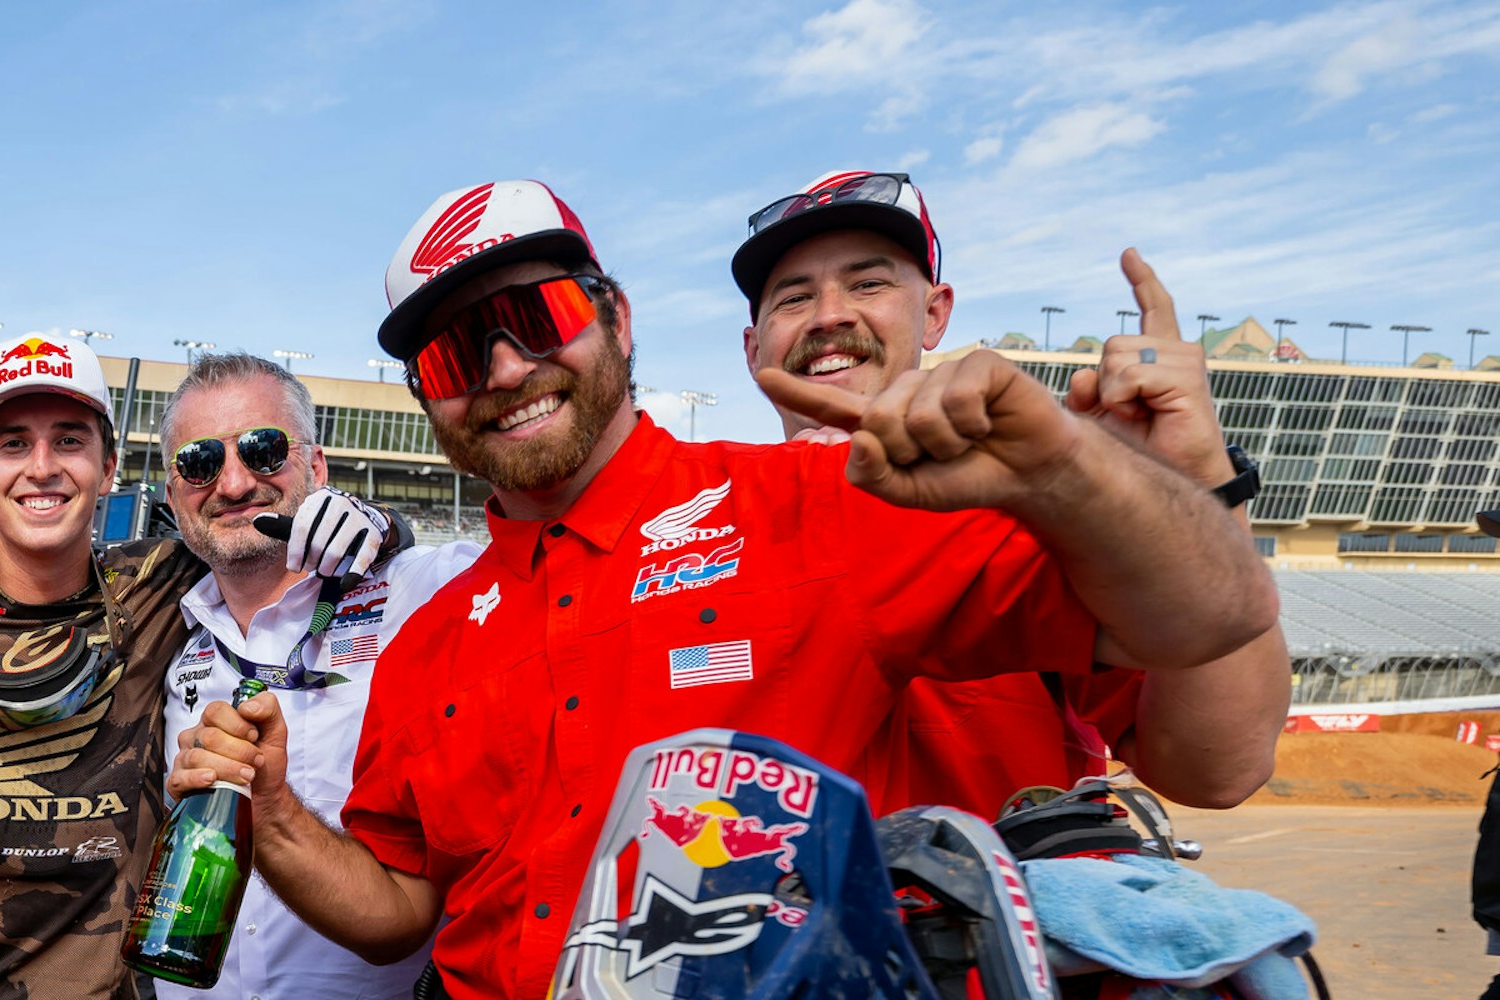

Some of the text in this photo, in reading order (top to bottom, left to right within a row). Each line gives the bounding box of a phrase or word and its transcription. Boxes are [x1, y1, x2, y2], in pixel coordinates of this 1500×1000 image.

[36, 359, 73, 380] Bull
[641, 524, 737, 557] HONDA
[631, 536, 746, 600] HRC
[682, 569, 738, 590] RACING
[341, 580, 390, 602] ONDA
[649, 747, 820, 820] Red Bull
[0, 847, 70, 858] DUNLOP
[137, 904, 172, 920] Place
[154, 895, 194, 915] Class
